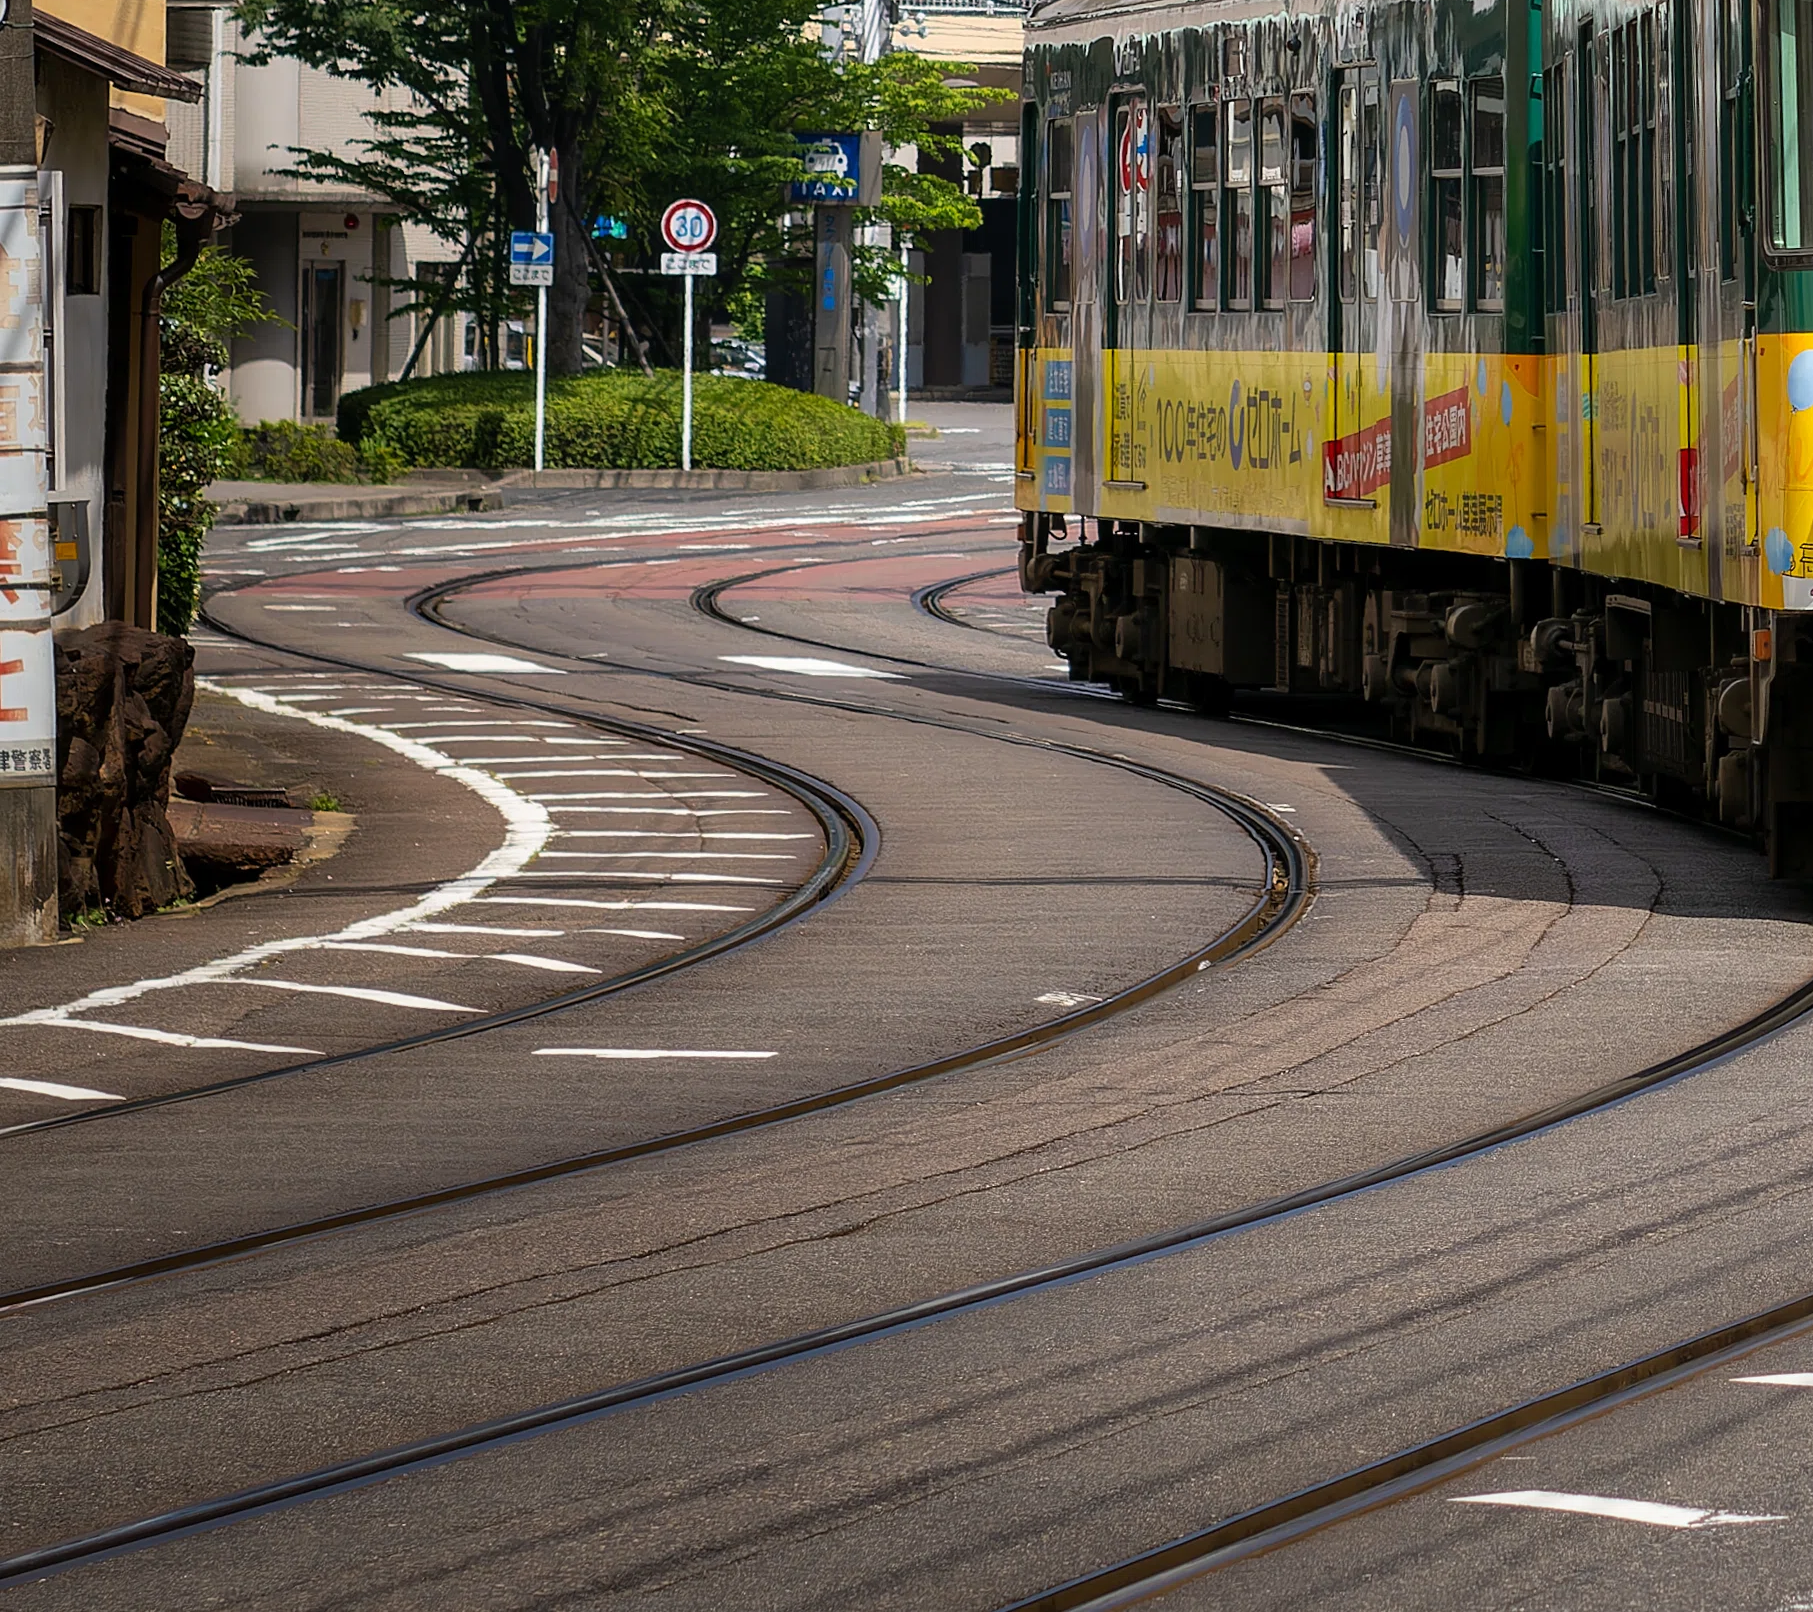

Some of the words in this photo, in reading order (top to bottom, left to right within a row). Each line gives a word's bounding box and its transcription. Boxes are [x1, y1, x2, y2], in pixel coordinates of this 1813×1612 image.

[675, 215, 704, 239] 30
[664, 257, 710, 271] ここまで
[1156, 397, 1227, 463] 100年住宅の
